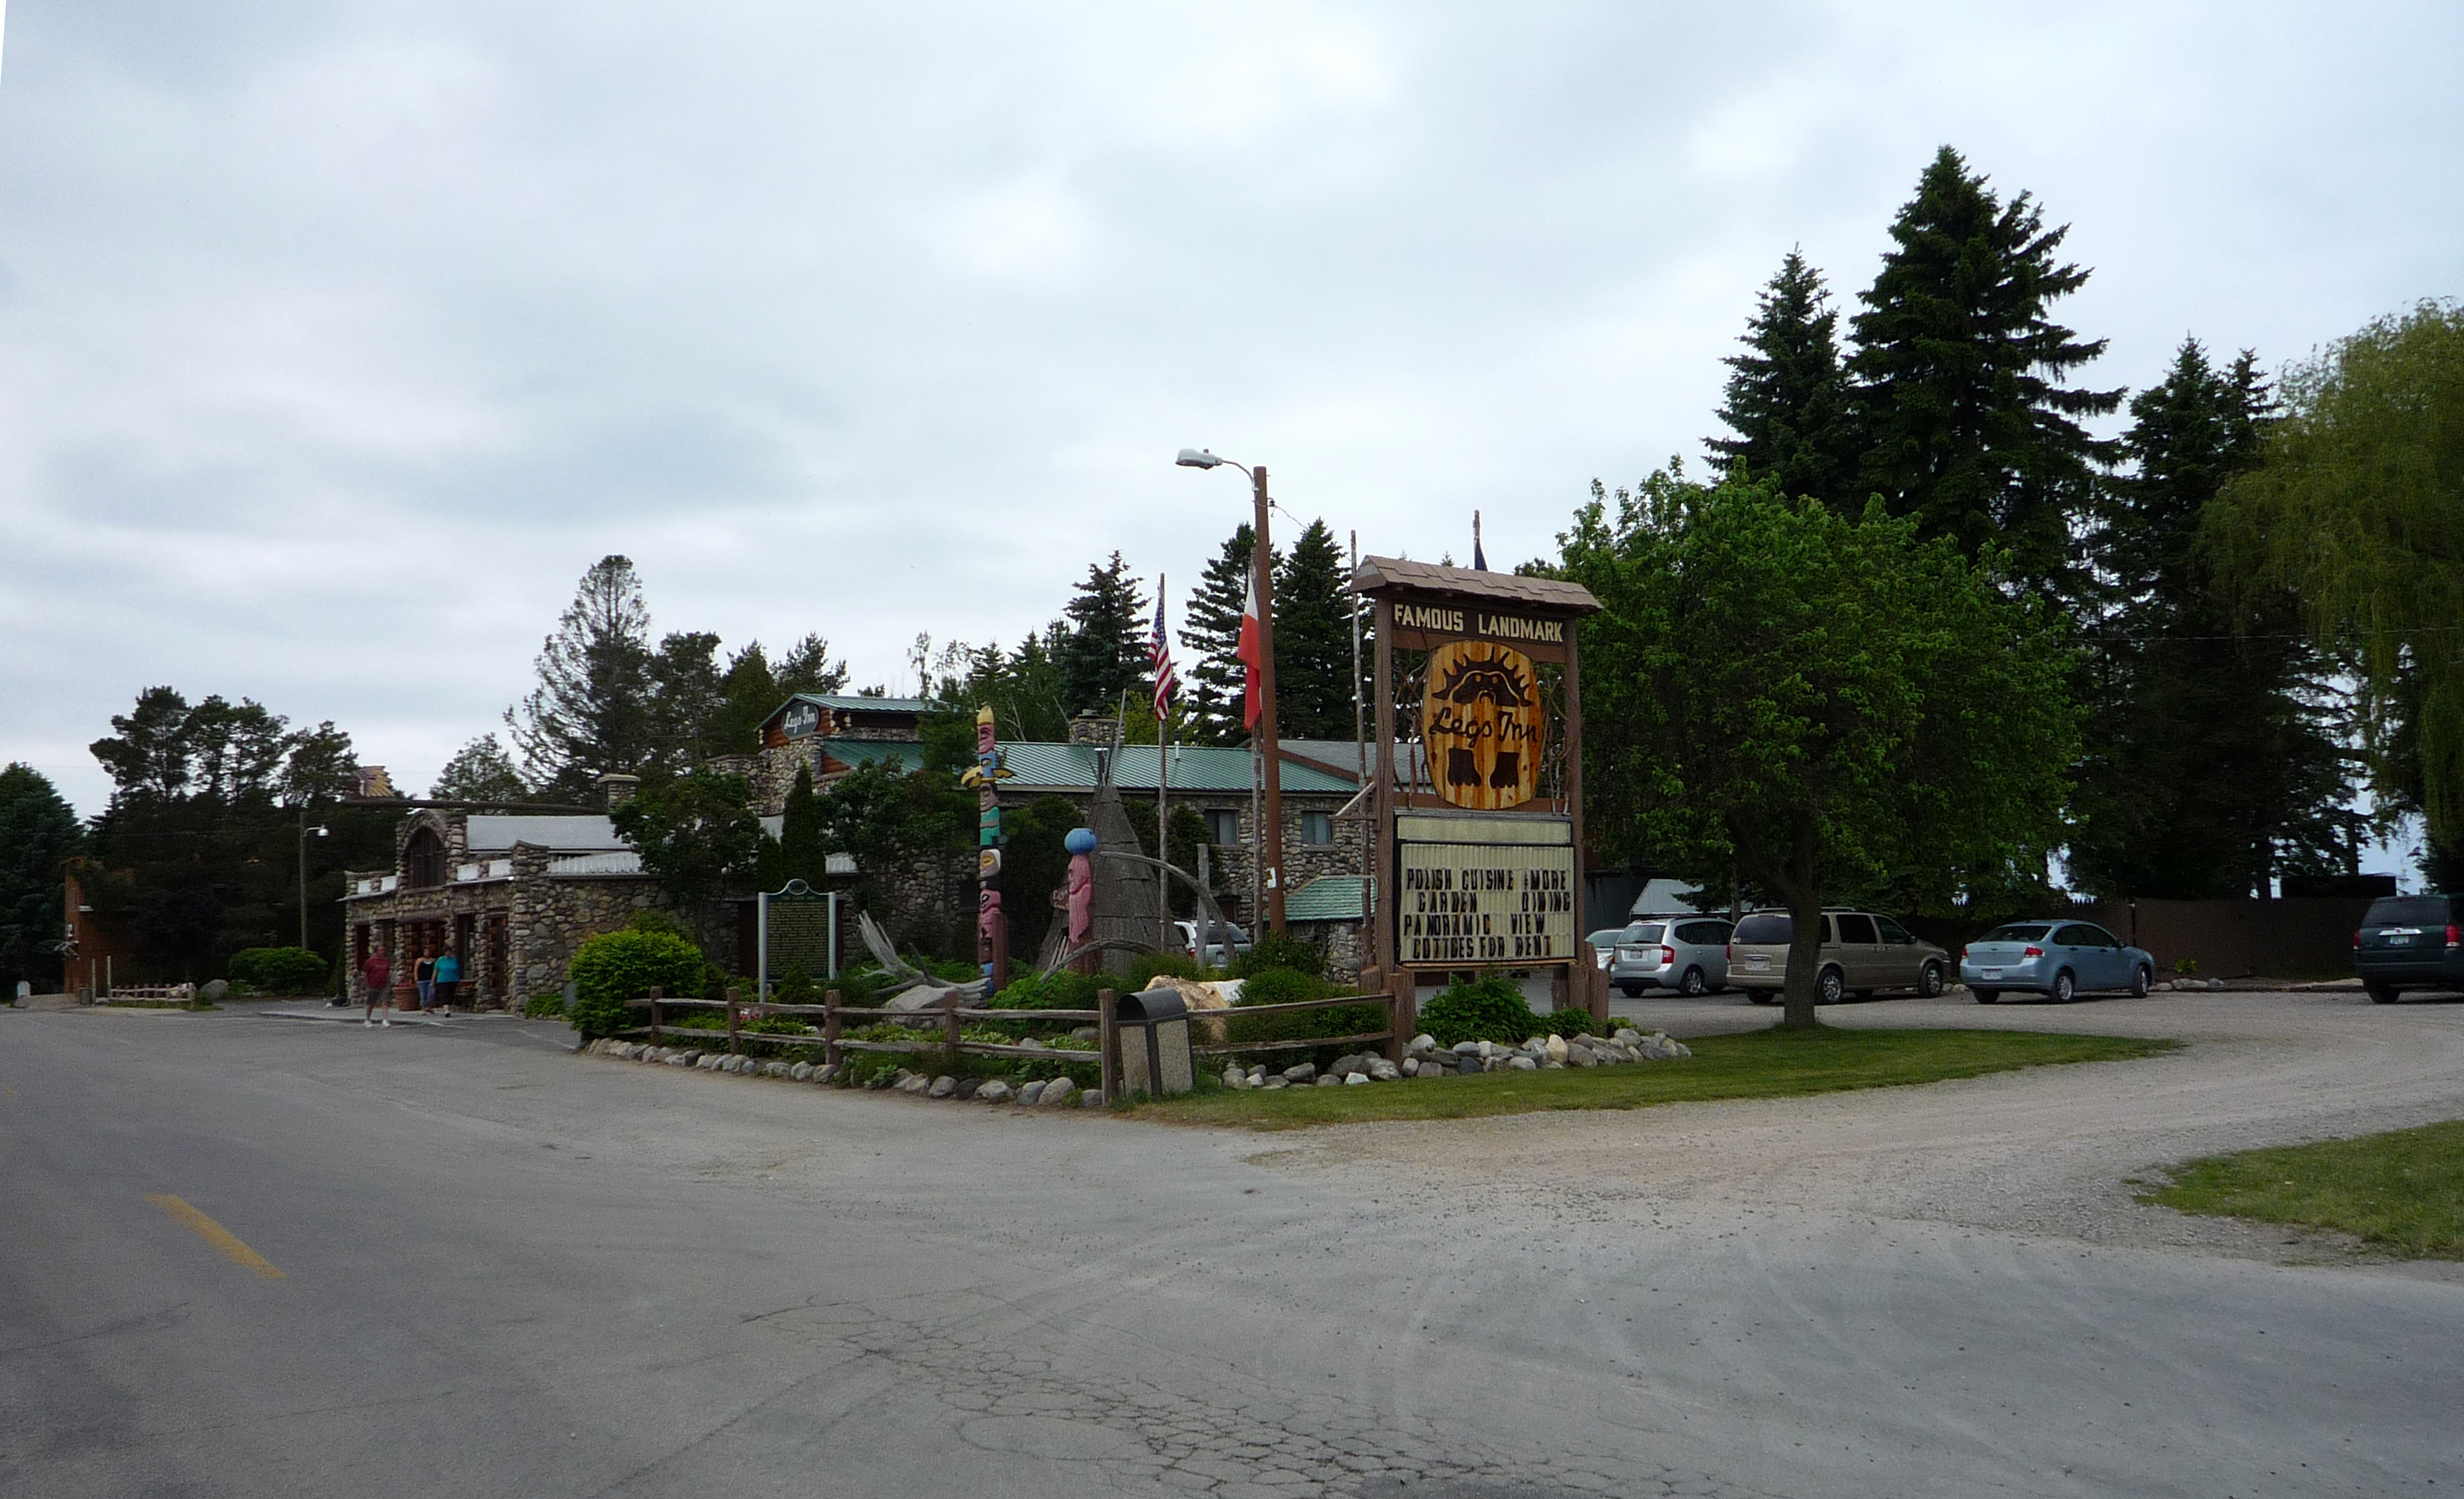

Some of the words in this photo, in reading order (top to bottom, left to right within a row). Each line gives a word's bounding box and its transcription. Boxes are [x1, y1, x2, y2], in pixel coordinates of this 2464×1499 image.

[1394, 604, 1464, 632] FAMOUS
[1478, 613, 1563, 643] LANDMARK
[784, 711, 802, 734] Legs
[1428, 707, 1493, 748] Legs
[1497, 710, 1538, 742] Inn
[1407, 868, 1451, 890] POLISH
[1462, 869, 1514, 890] CUISINE
[1418, 892, 1477, 913] GARDEN
[1522, 892, 1571, 912] DINING
[1404, 914, 1491, 936] PANORAMIC
[1511, 914, 1545, 934] VIEW
[1480, 938, 1505, 957] FOR
[1515, 935, 1552, 956] RENT
